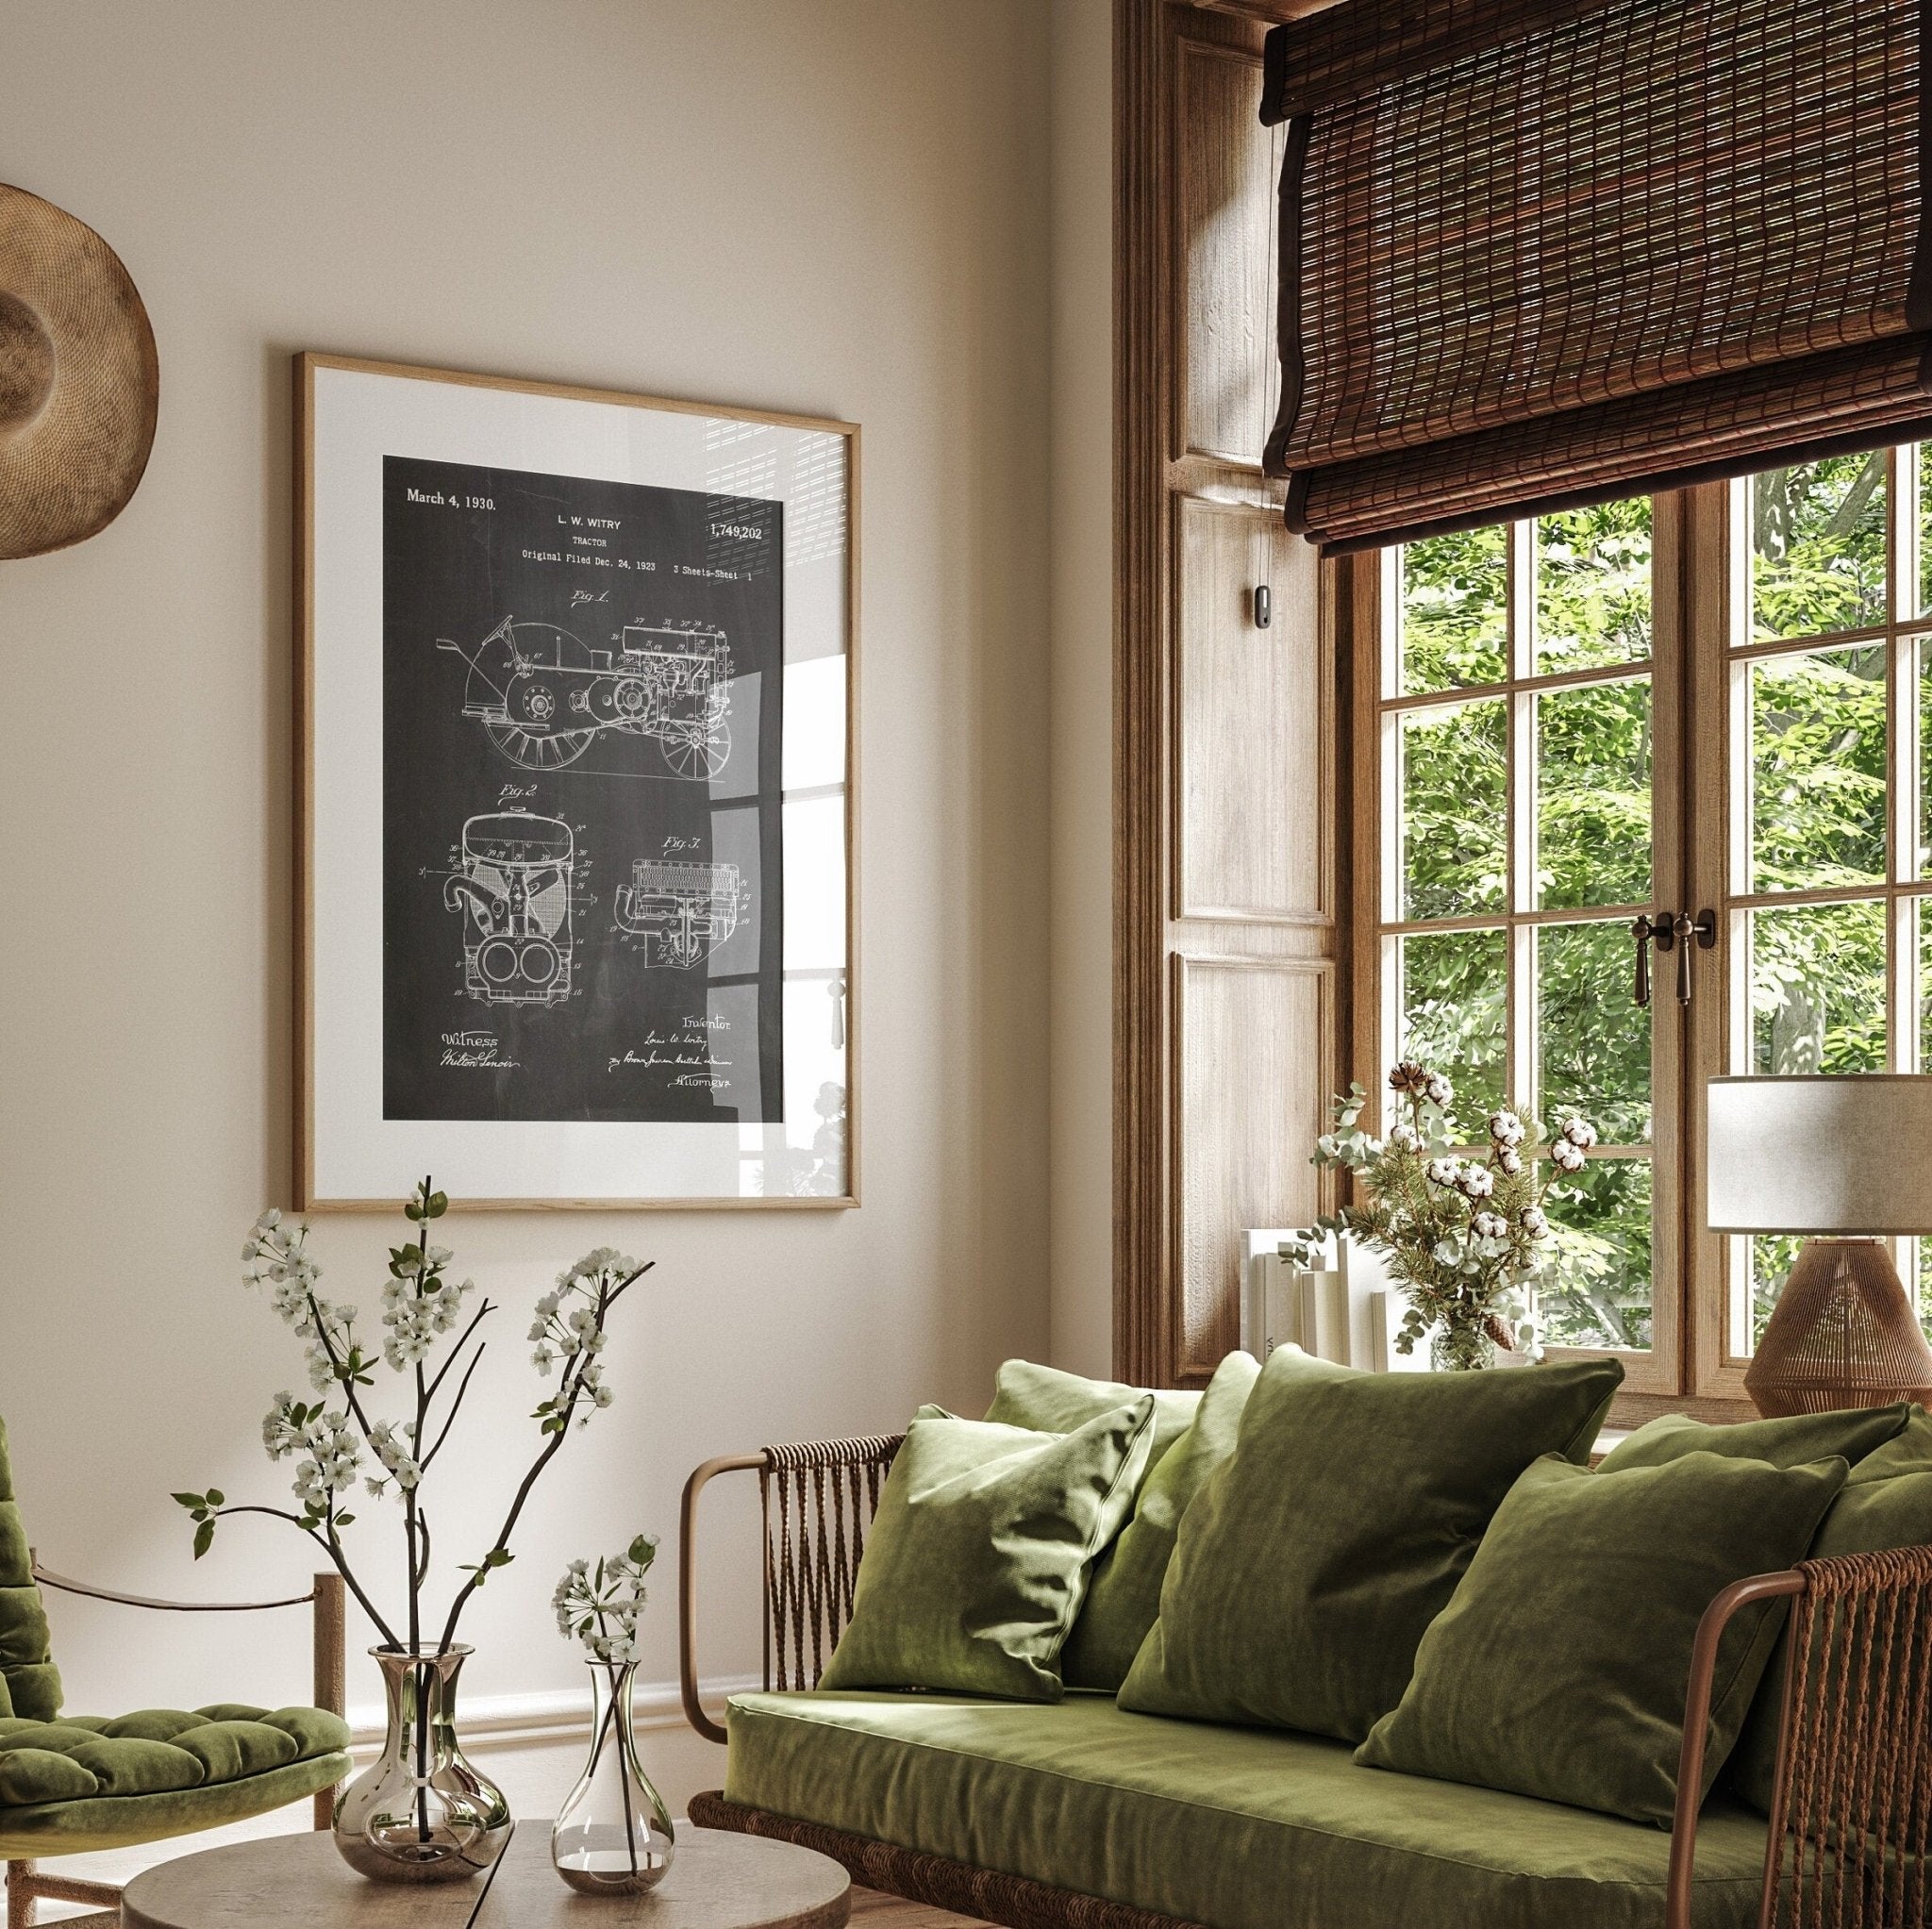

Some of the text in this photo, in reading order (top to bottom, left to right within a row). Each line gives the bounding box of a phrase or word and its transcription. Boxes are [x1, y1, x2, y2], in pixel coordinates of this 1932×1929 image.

[407, 488, 496, 510] March 4, 1930.
[558, 514, 621, 530] L. W. WITRY
[710, 524, 762, 540] 1,749,202
[572, 536, 607, 547] TRACTOR
[522, 549, 656, 572] Original Filed Dec. 24, 1923
[674, 565, 753, 581] 3 Sheets-Sheet 1
[571, 590, 594, 608] Fig.
[498, 785, 524, 806] Fig.
[661, 836, 687, 856] Fig.
[682, 1013, 731, 1030] Inventor
[441, 1030, 498, 1047] Witness
